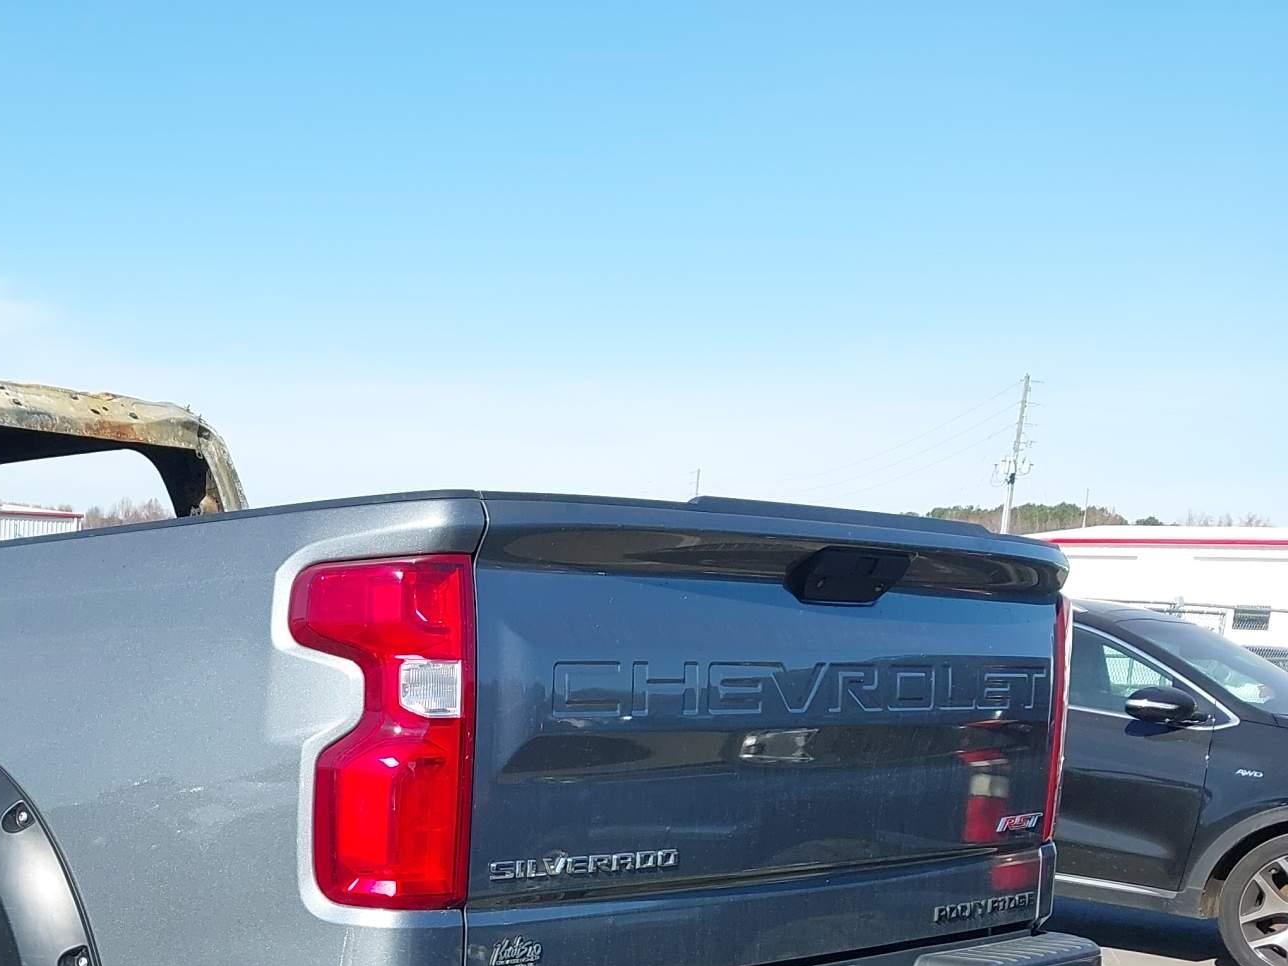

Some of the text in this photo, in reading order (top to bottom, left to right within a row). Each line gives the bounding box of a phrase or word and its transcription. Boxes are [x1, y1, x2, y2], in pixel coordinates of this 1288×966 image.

[552, 660, 1047, 718] CHEVROLET
[1234, 768, 1264, 778] AWD
[996, 812, 1044, 833] RST
[489, 848, 679, 881] SILVERADO
